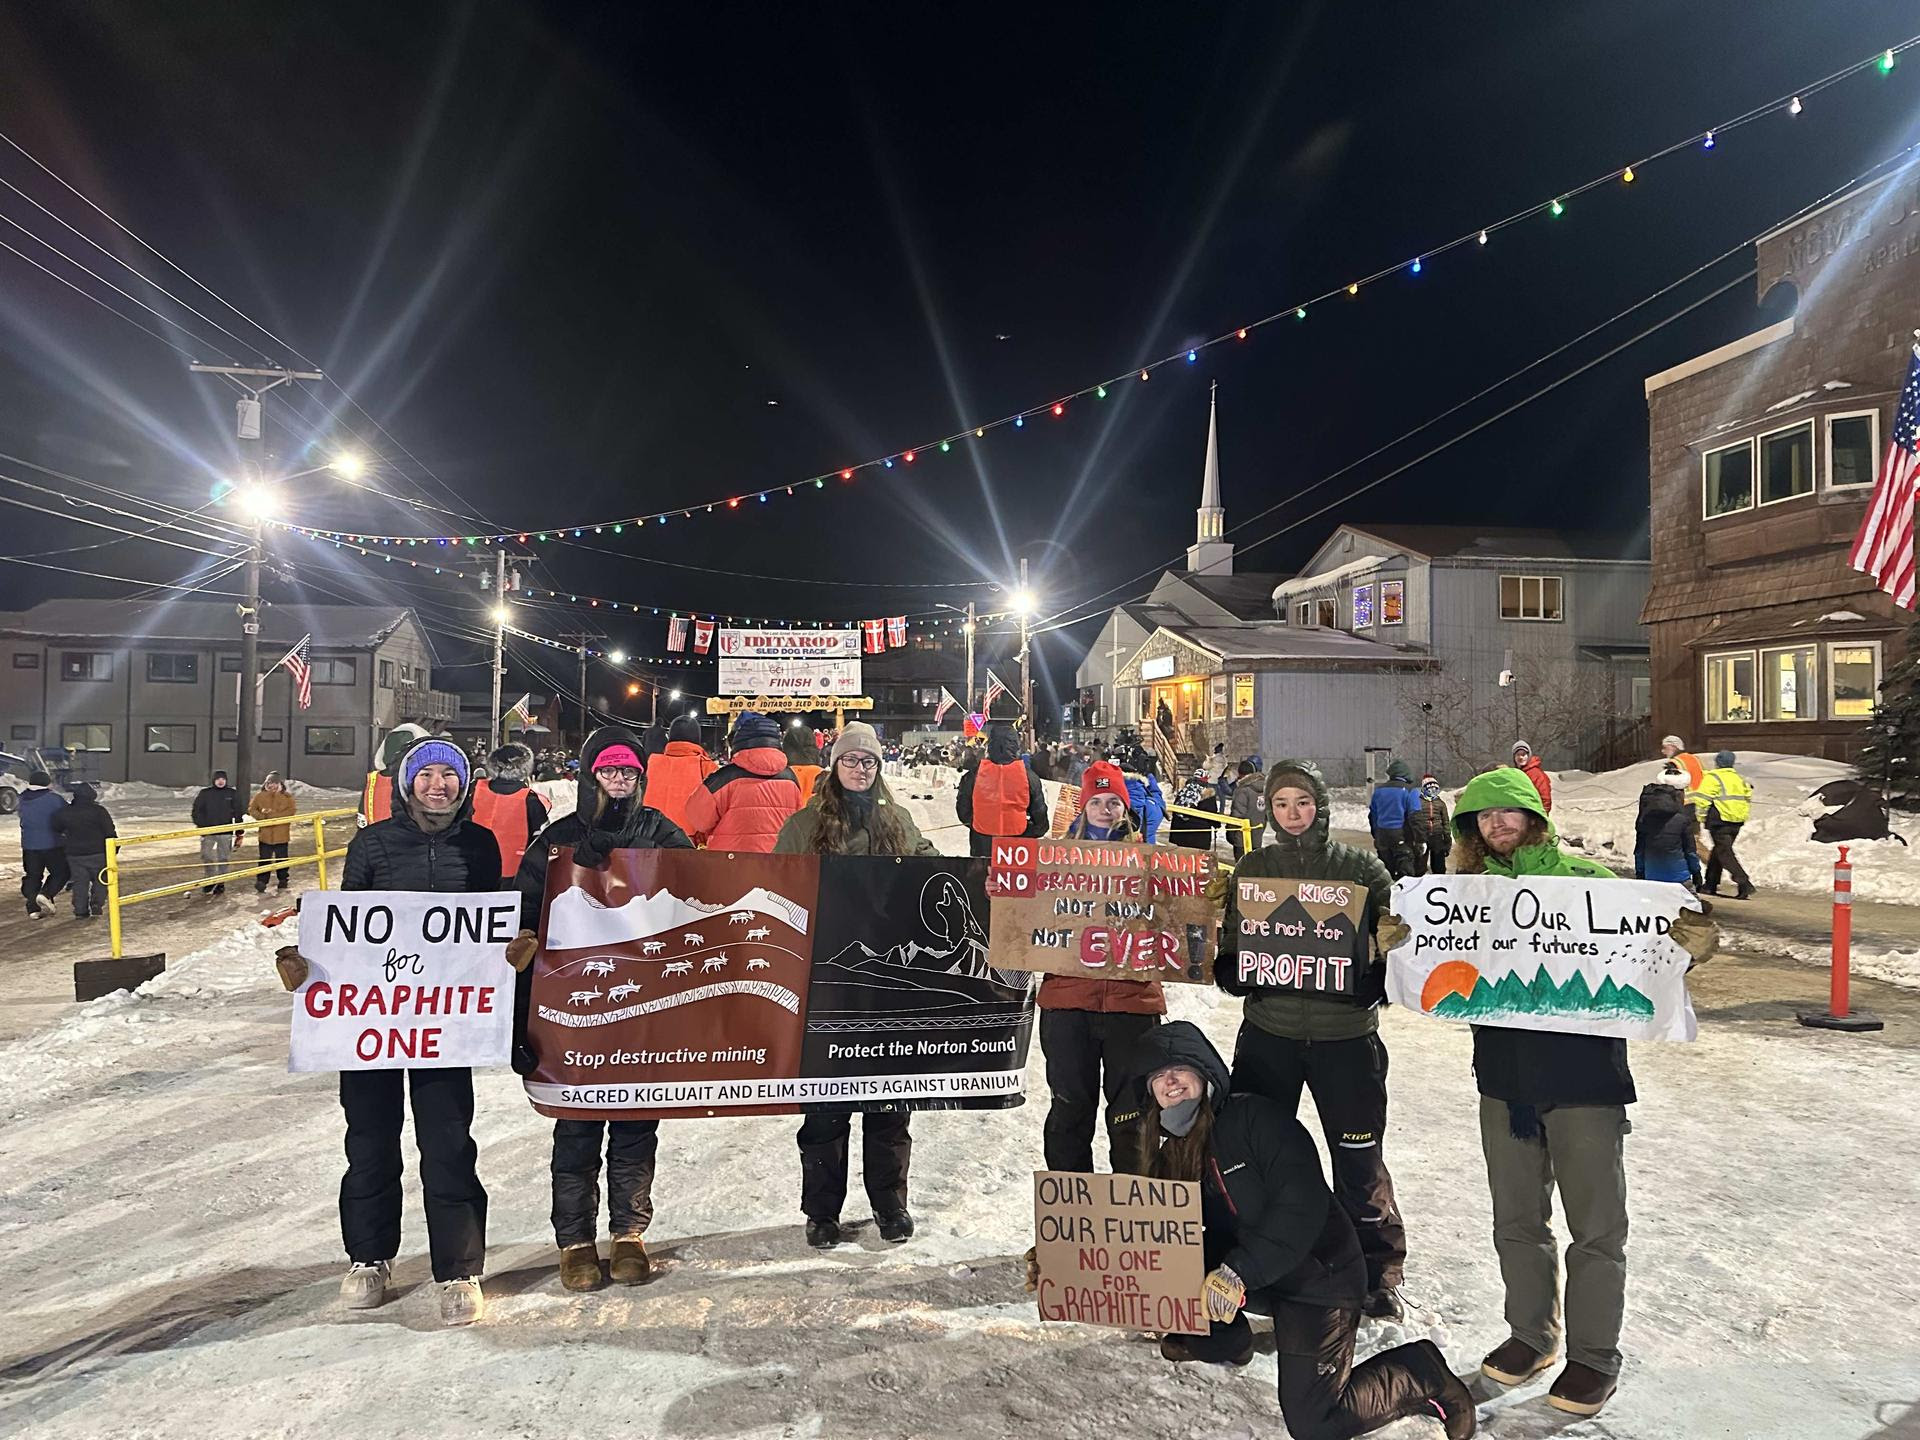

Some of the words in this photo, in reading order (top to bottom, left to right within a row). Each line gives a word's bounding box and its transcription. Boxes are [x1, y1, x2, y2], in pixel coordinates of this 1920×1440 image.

[744, 636, 838, 648] IDITAROD
[769, 678, 812, 687] FINISH
[996, 846, 1029, 866] NO
[1038, 845, 1146, 870] URANIUM
[1151, 851, 1210, 874] MINE
[996, 871, 1029, 891] NO
[1035, 871, 1142, 897] GRAPHITE
[1148, 874, 1210, 897] MINE
[1238, 883, 1276, 902] The
[1298, 883, 1351, 906] KIGS
[1054, 897, 1096, 917] NOT
[1104, 900, 1154, 920] NOW
[324, 904, 393, 944] NO
[422, 905, 515, 944] ONE
[1240, 919, 1270, 936] are
[1275, 920, 1305, 937] not
[1314, 920, 1343, 940] for
[1031, 927, 1074, 948] NOT
[1415, 929, 1480, 955] protect
[1492, 935, 1517, 951] our
[1529, 932, 1599, 956] futures
[382, 948, 424, 982] for
[1238, 951, 1352, 992] PROFIT
[304, 981, 495, 1018] GRAPHITE
[356, 1028, 442, 1061] ONE
[563, 1050, 605, 1069] Stop
[609, 1047, 707, 1065] destructive
[711, 1046, 767, 1064] mining
[828, 1040, 885, 1059] Protect
[888, 1040, 913, 1056] the
[917, 1039, 967, 1055] Norton
[970, 1036, 1016, 1053] Sound
[561, 1089, 629, 1103] SACRED
[634, 1086, 714, 1102] KIGLUAIT
[717, 1084, 752, 1100] AND
[757, 1083, 795, 1098] ELIM
[799, 1080, 878, 1097] STUDENTS
[882, 1078, 946, 1094] AGAINST
[949, 1074, 1020, 1091] URANIUM
[1039, 1177, 1093, 1206] OUR
[1110, 1179, 1190, 1208] LAND
[1040, 1215, 1096, 1243] OUR
[1104, 1217, 1200, 1246] FUTURE
[1079, 1247, 1110, 1271] NO
[1119, 1250, 1162, 1271] ONE
[1102, 1274, 1140, 1292] FOR
[1040, 1279, 1152, 1328] GRAPHITE
[1157, 1295, 1206, 1333] ONE
